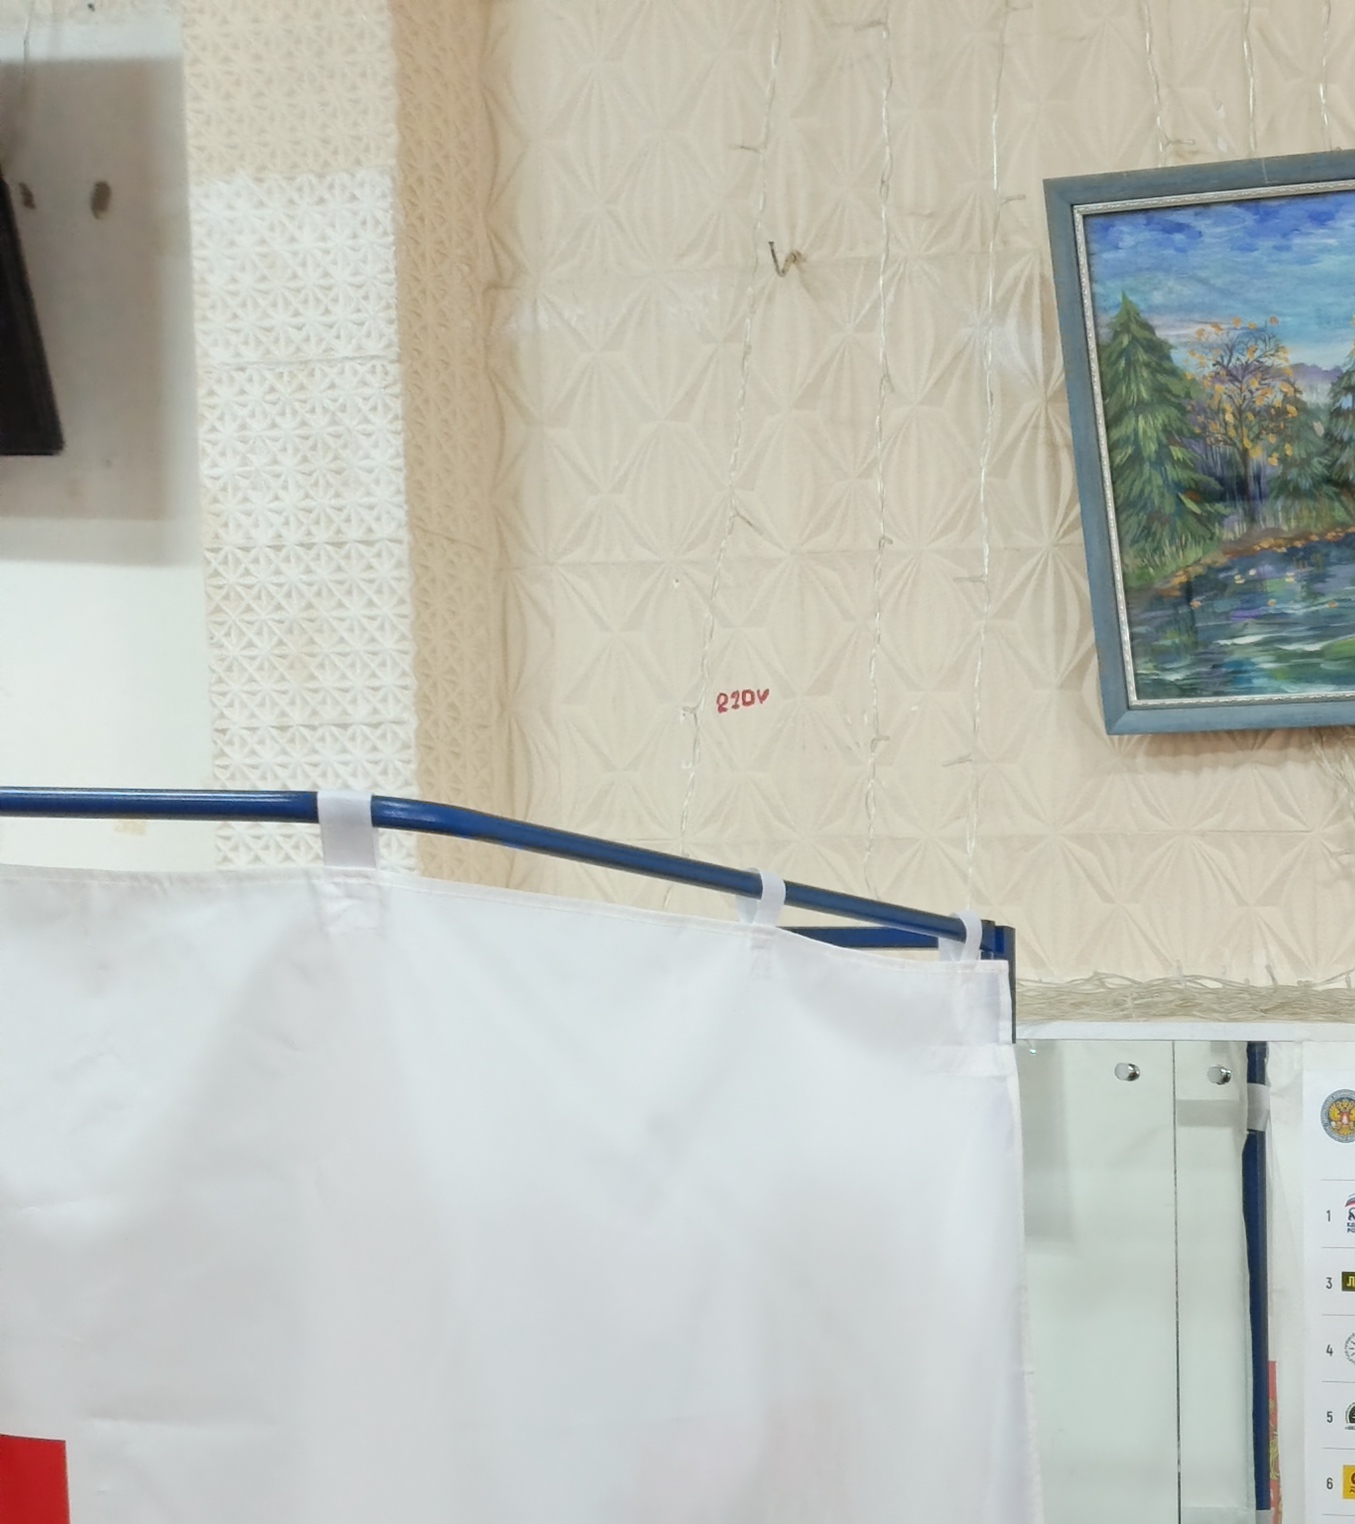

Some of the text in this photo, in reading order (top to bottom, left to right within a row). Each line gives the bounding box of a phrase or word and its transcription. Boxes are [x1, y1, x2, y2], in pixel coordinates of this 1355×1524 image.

[1326, 1209, 1332, 1222] 1
[1325, 1277, 1333, 1290] 3
[1325, 1343, 1333, 1356] 4
[1326, 1410, 1334, 1423] 5
[1326, 1477, 1334, 1490] 6
